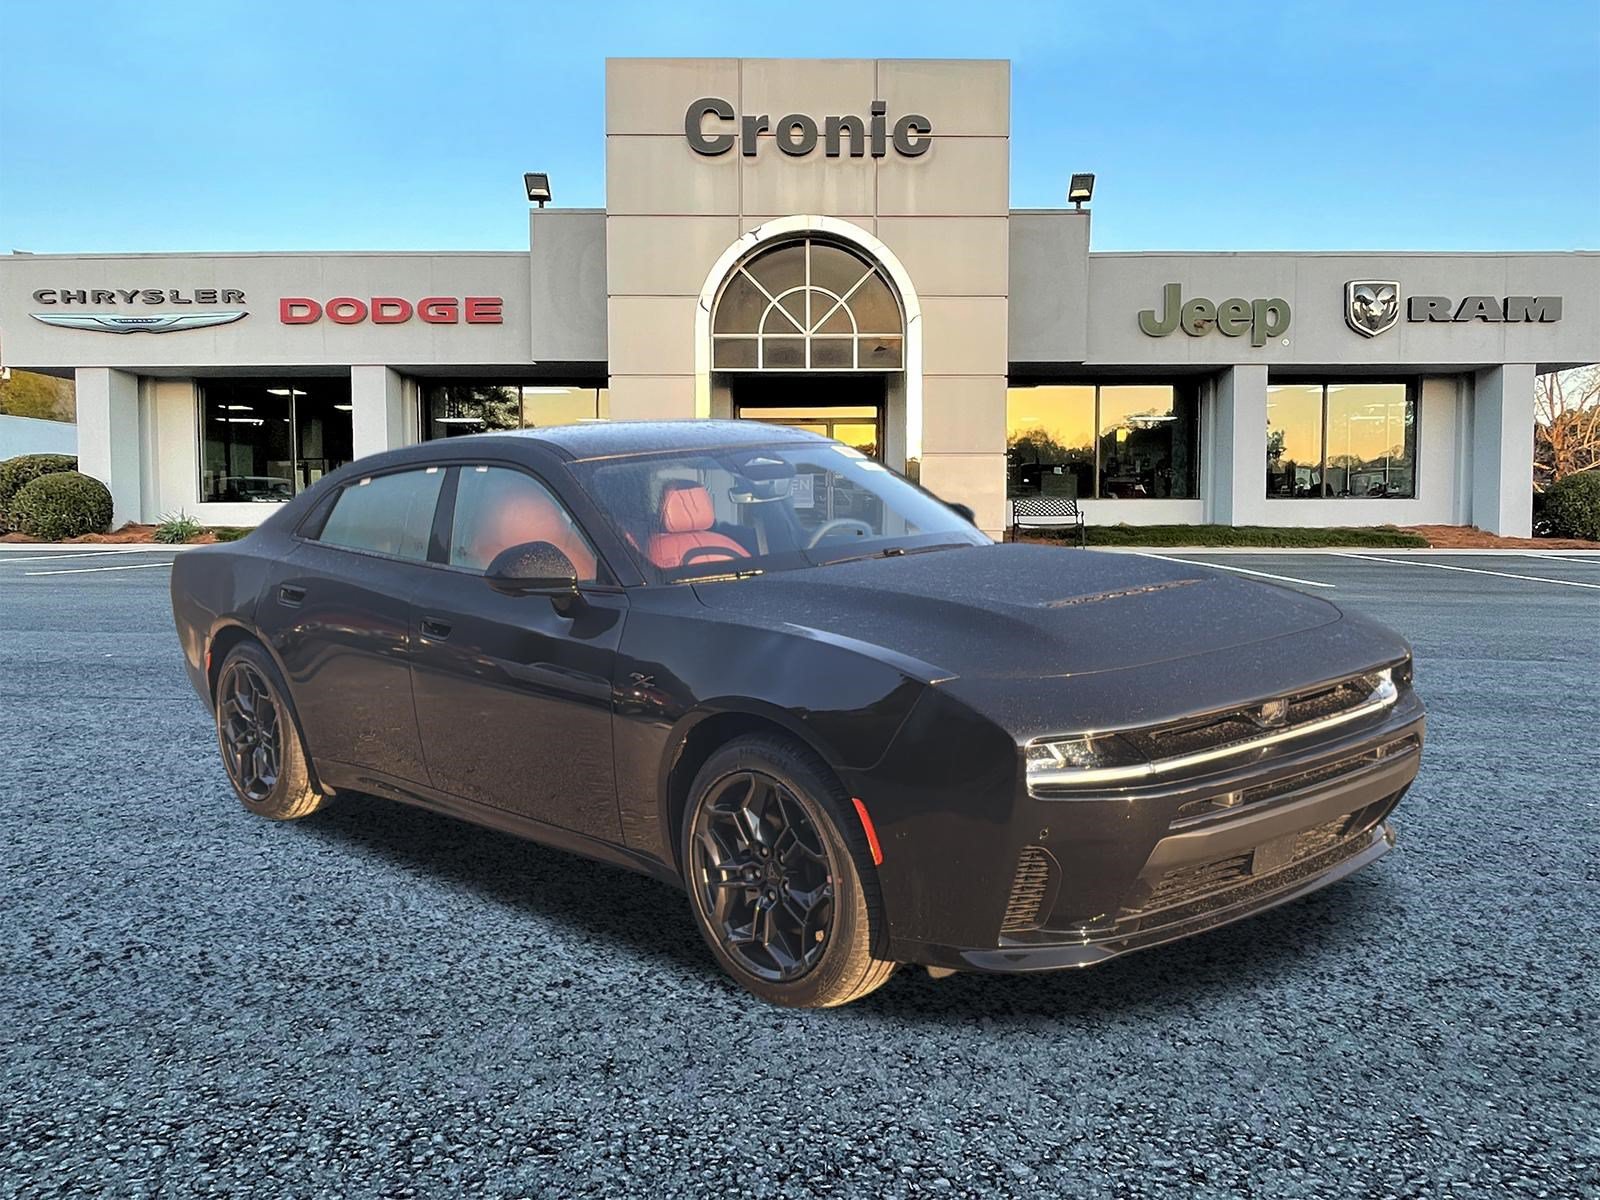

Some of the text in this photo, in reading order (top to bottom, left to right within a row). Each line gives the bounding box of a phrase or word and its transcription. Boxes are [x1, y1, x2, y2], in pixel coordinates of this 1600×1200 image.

[685, 97, 931, 158] Cronic
[33, 289, 246, 304] CHRYSLER
[1407, 296, 1562, 323] RAM
[280, 297, 503, 325] DODGE
[1138, 283, 1291, 347] Jeep
